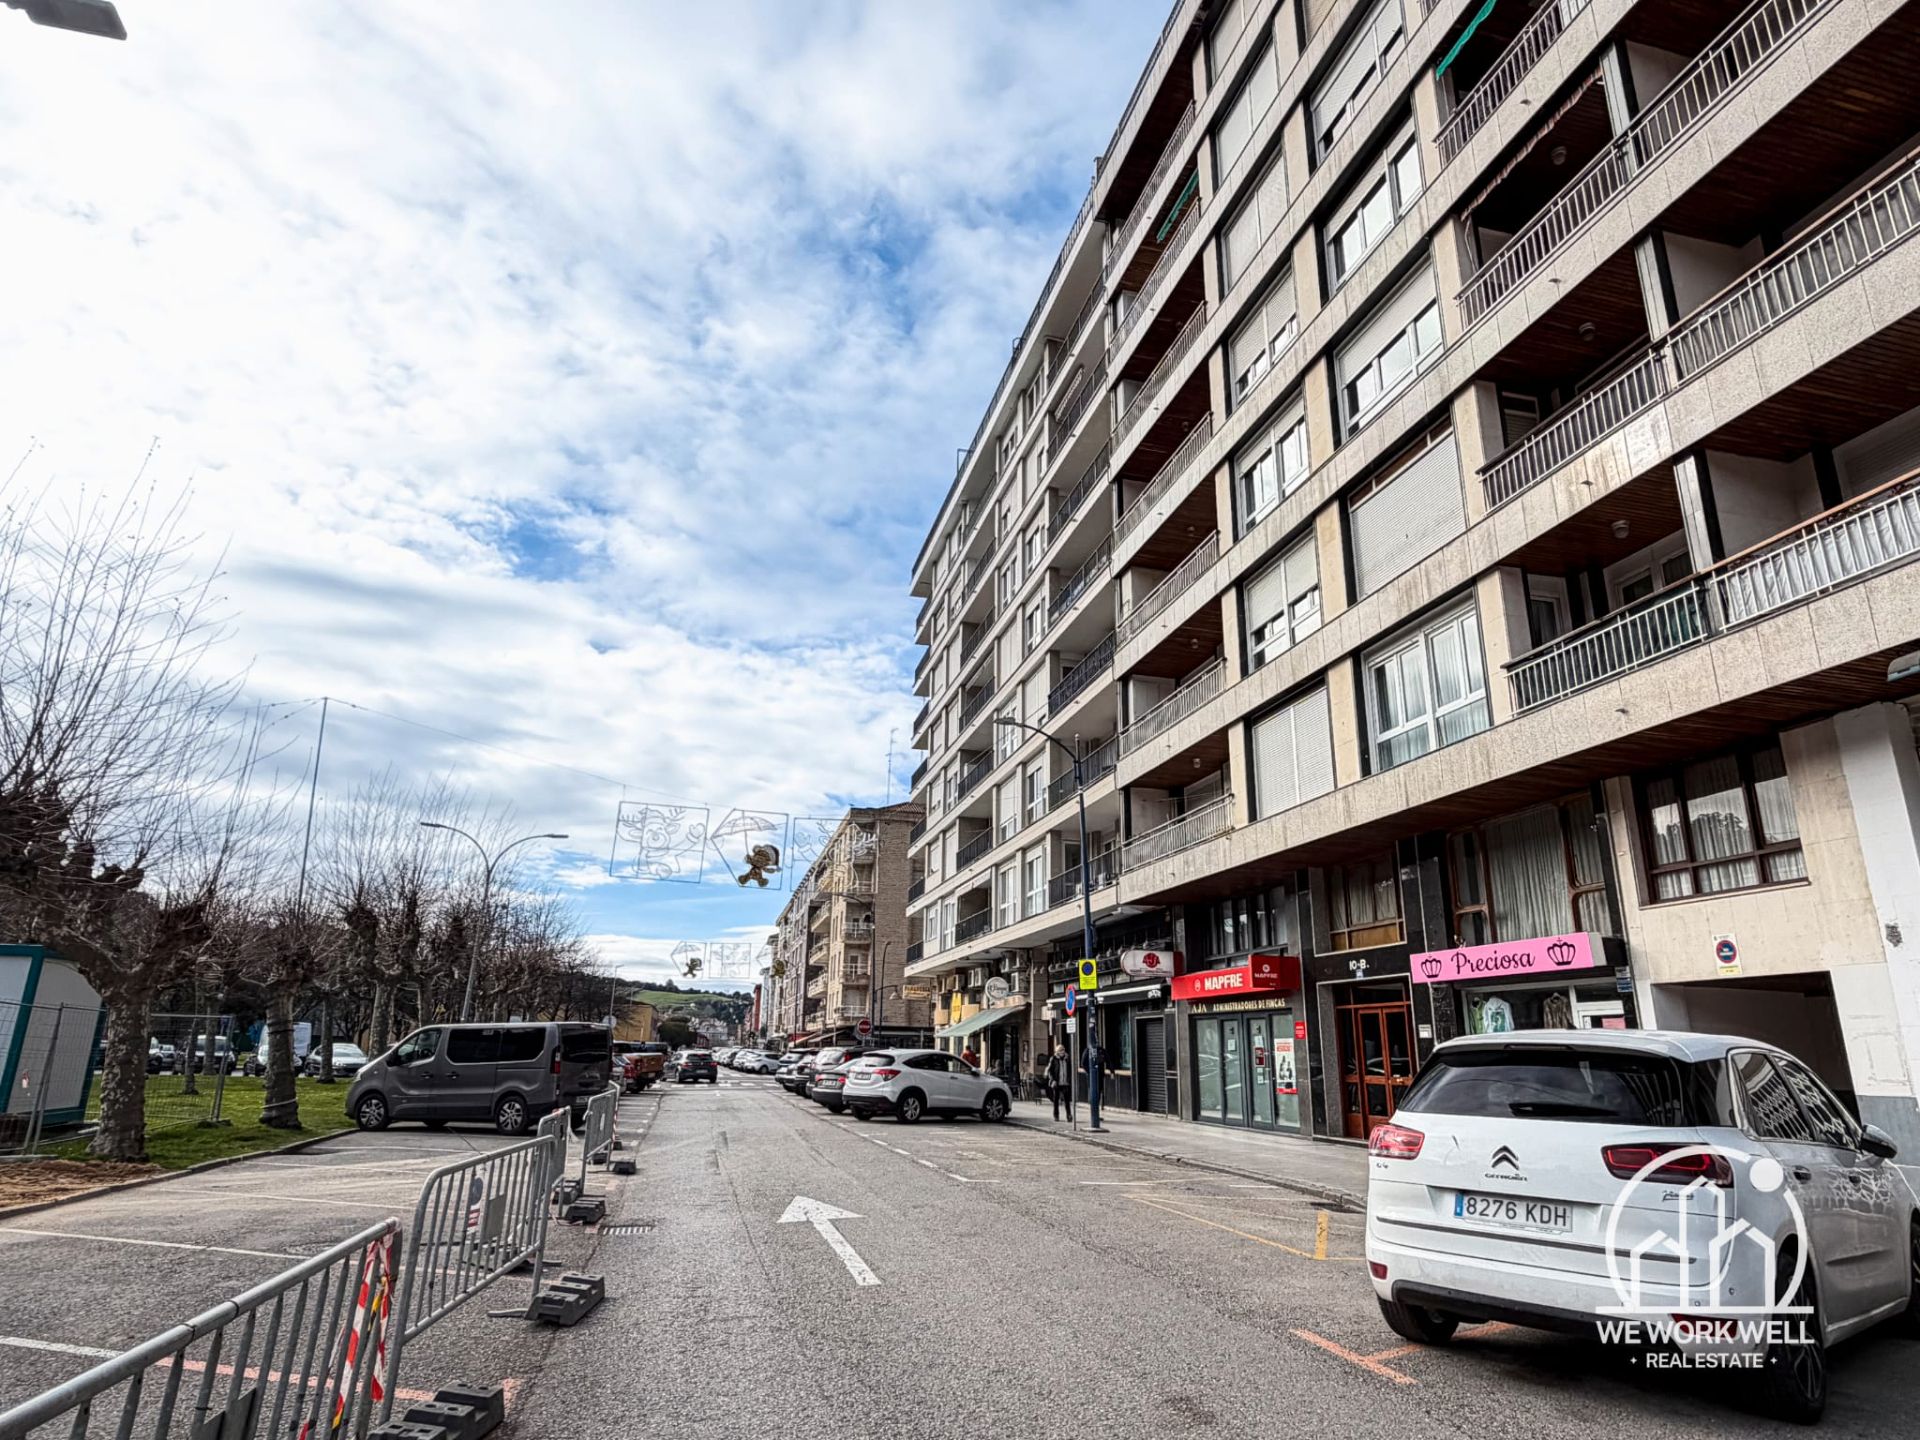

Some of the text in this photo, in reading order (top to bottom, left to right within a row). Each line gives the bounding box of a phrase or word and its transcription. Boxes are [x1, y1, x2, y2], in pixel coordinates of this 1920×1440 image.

[1451, 950, 1536, 975] Preciosa
[1204, 973, 1243, 990] MAPFRE
[1213, 1000, 1257, 1012] ADMINISTRADORES
[1258, 999, 1265, 1009] DE
[1266, 997, 1285, 1008] FINCAS
[1466, 1197, 1567, 1226] 8276 KDH
